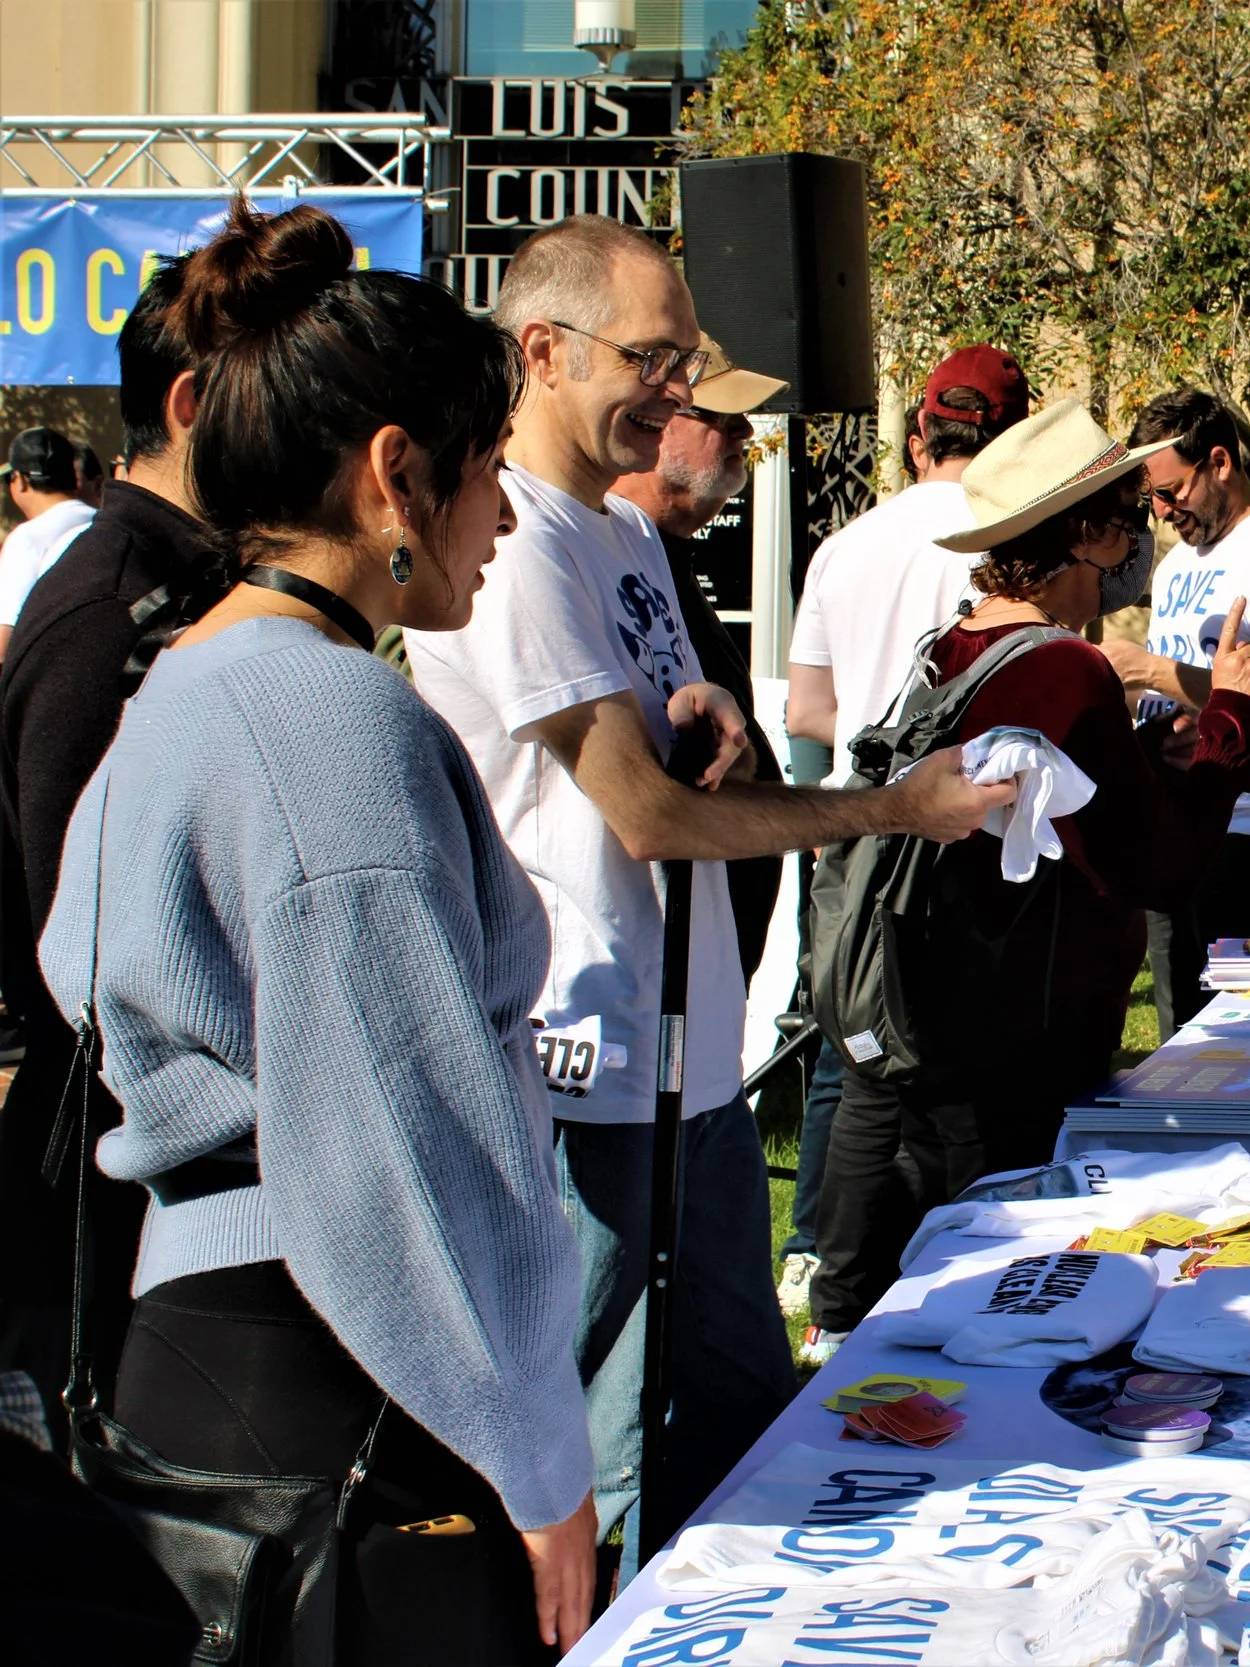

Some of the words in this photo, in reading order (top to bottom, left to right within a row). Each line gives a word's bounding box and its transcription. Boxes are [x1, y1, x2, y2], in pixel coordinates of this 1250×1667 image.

[492, 79, 630, 138] LUIS
[1157, 569, 1226, 618] SAVE
[537, 1036, 596, 1081] CLE
[779, 1596, 951, 1667] SAV
